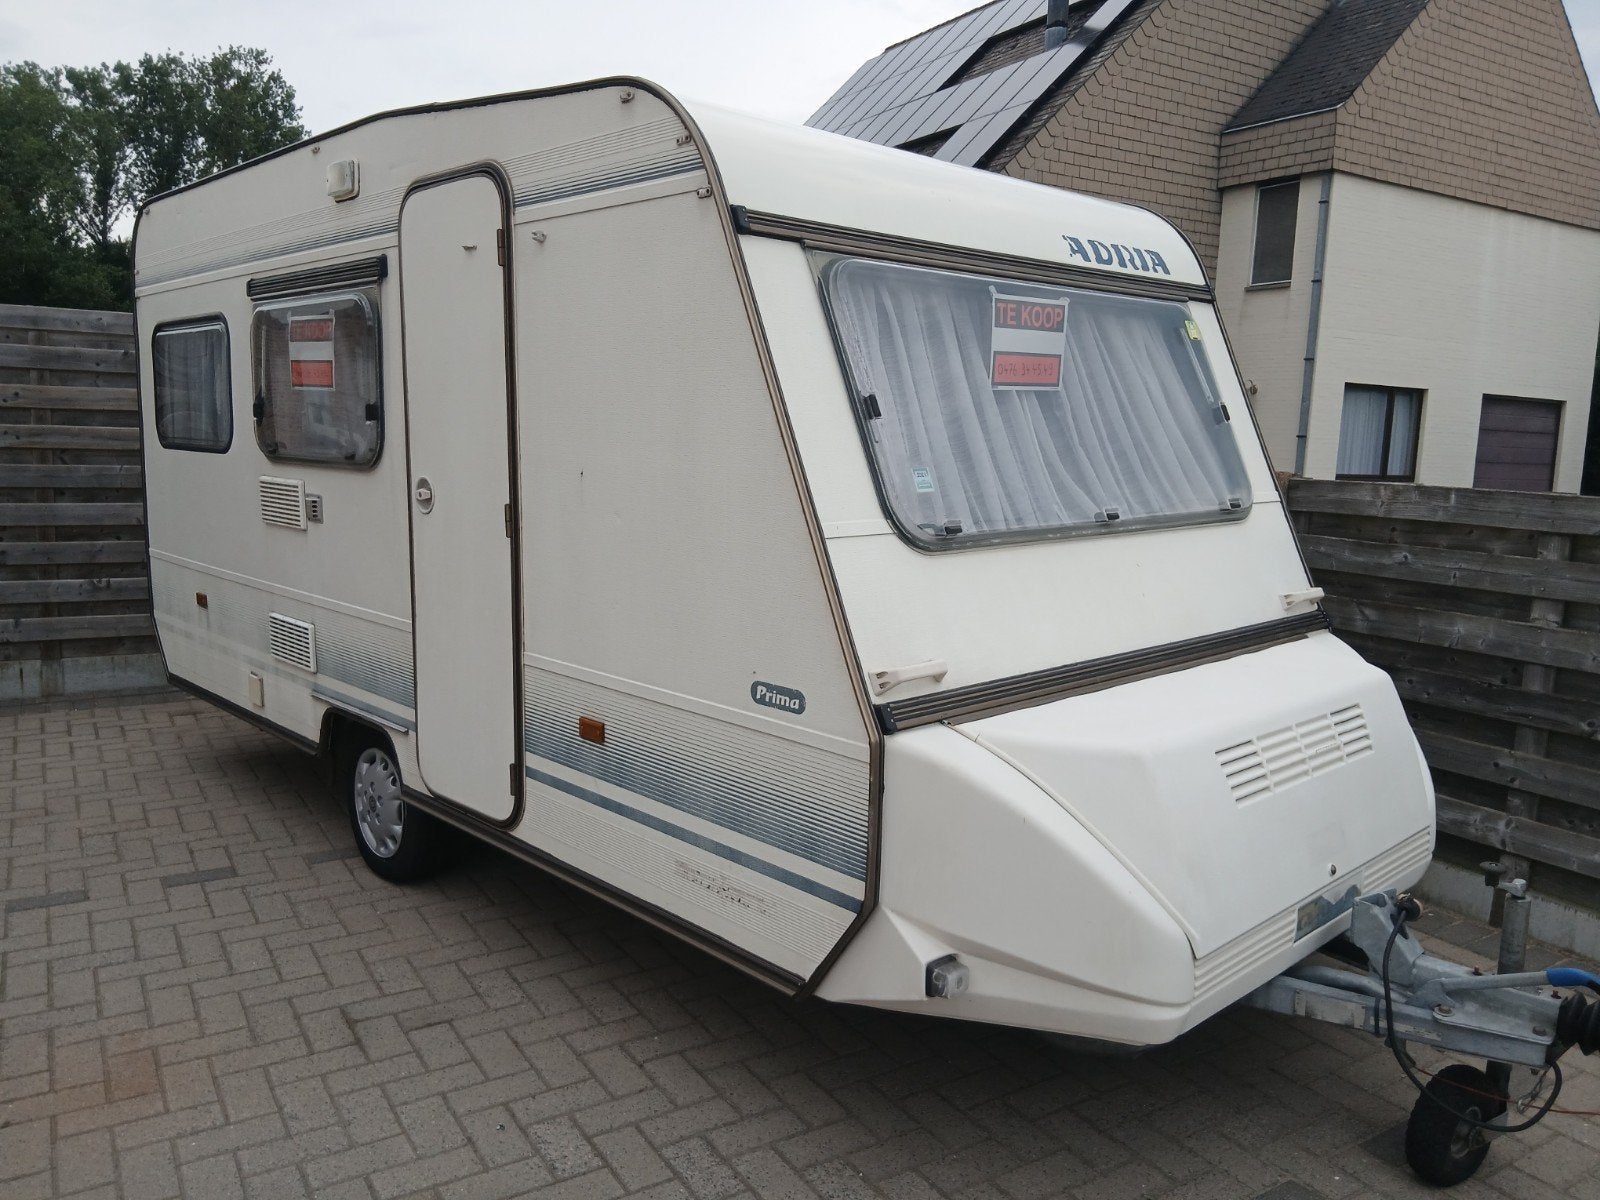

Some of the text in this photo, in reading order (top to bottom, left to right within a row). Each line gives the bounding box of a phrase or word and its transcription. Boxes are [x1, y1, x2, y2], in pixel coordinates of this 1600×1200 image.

[1061, 235, 1171, 275] ADRIA
[997, 303, 1063, 328] TE KOOP
[756, 685, 800, 709] Prima
